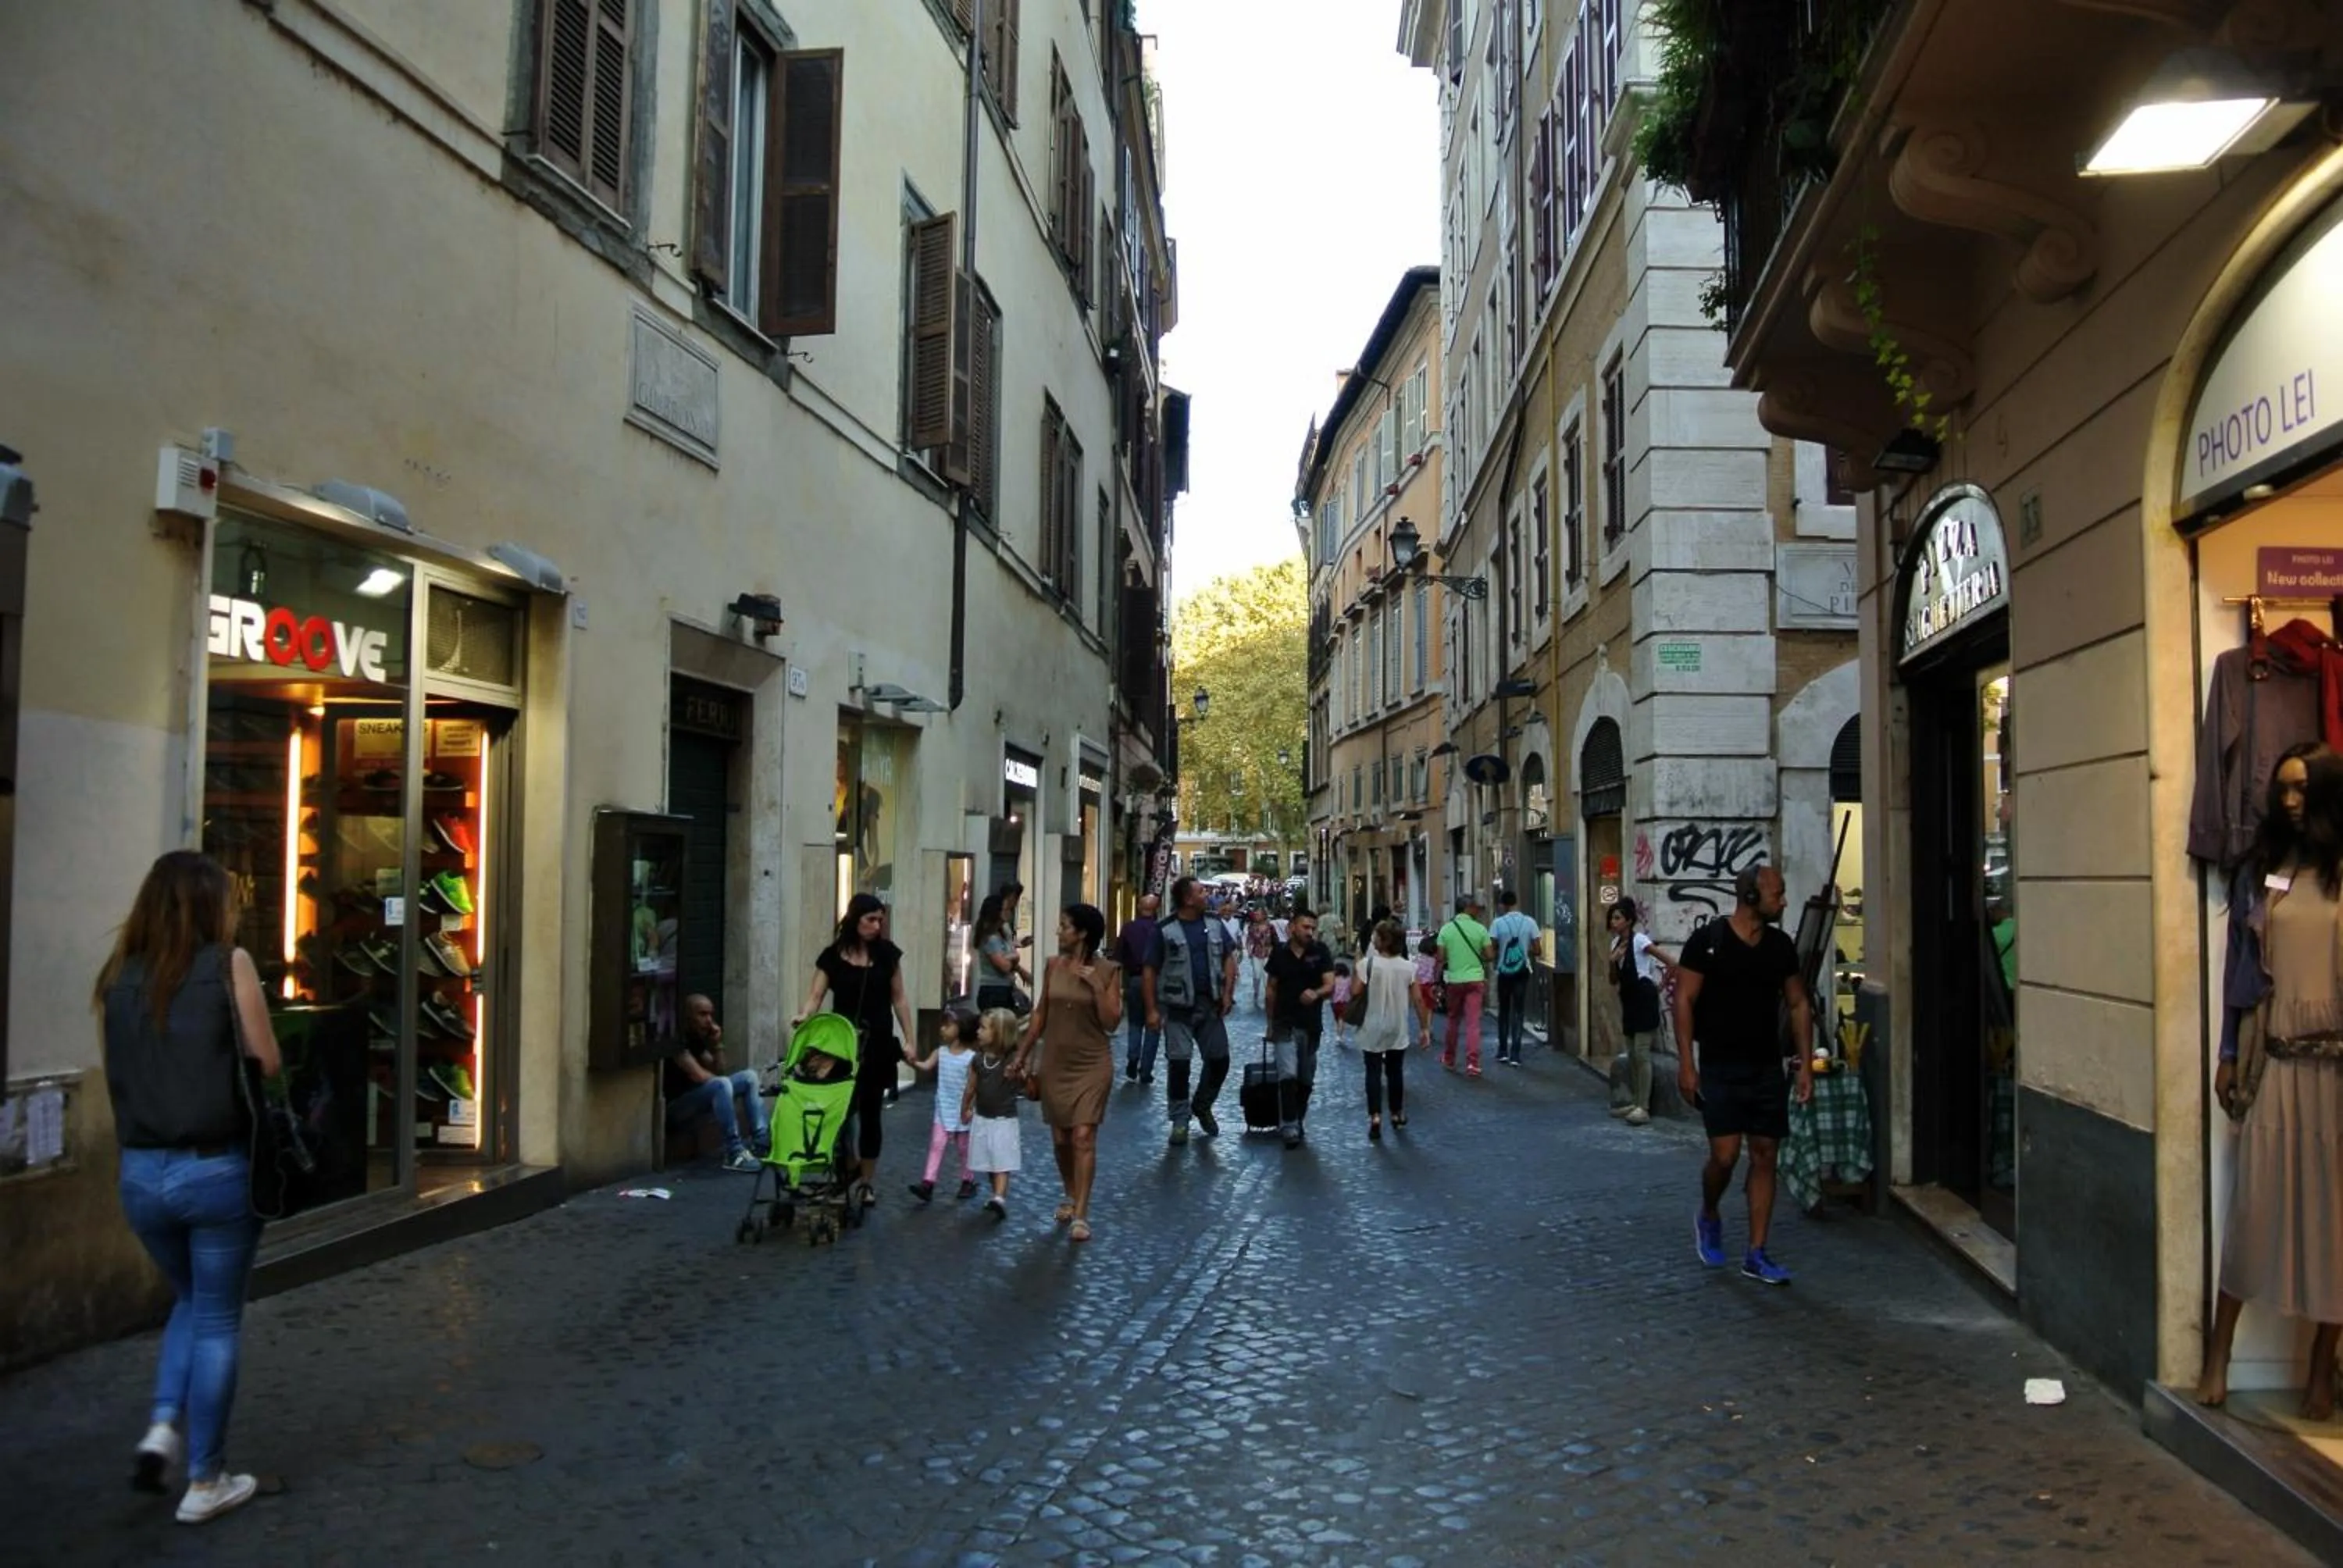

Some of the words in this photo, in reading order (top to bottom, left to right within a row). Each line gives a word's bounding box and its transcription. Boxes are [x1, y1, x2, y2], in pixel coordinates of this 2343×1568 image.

[2198, 396, 2272, 479] PHOTO
[2280, 369, 2315, 433] LEI
[2266, 571, 2297, 586] New
[208, 594, 387, 683] GROOVE
